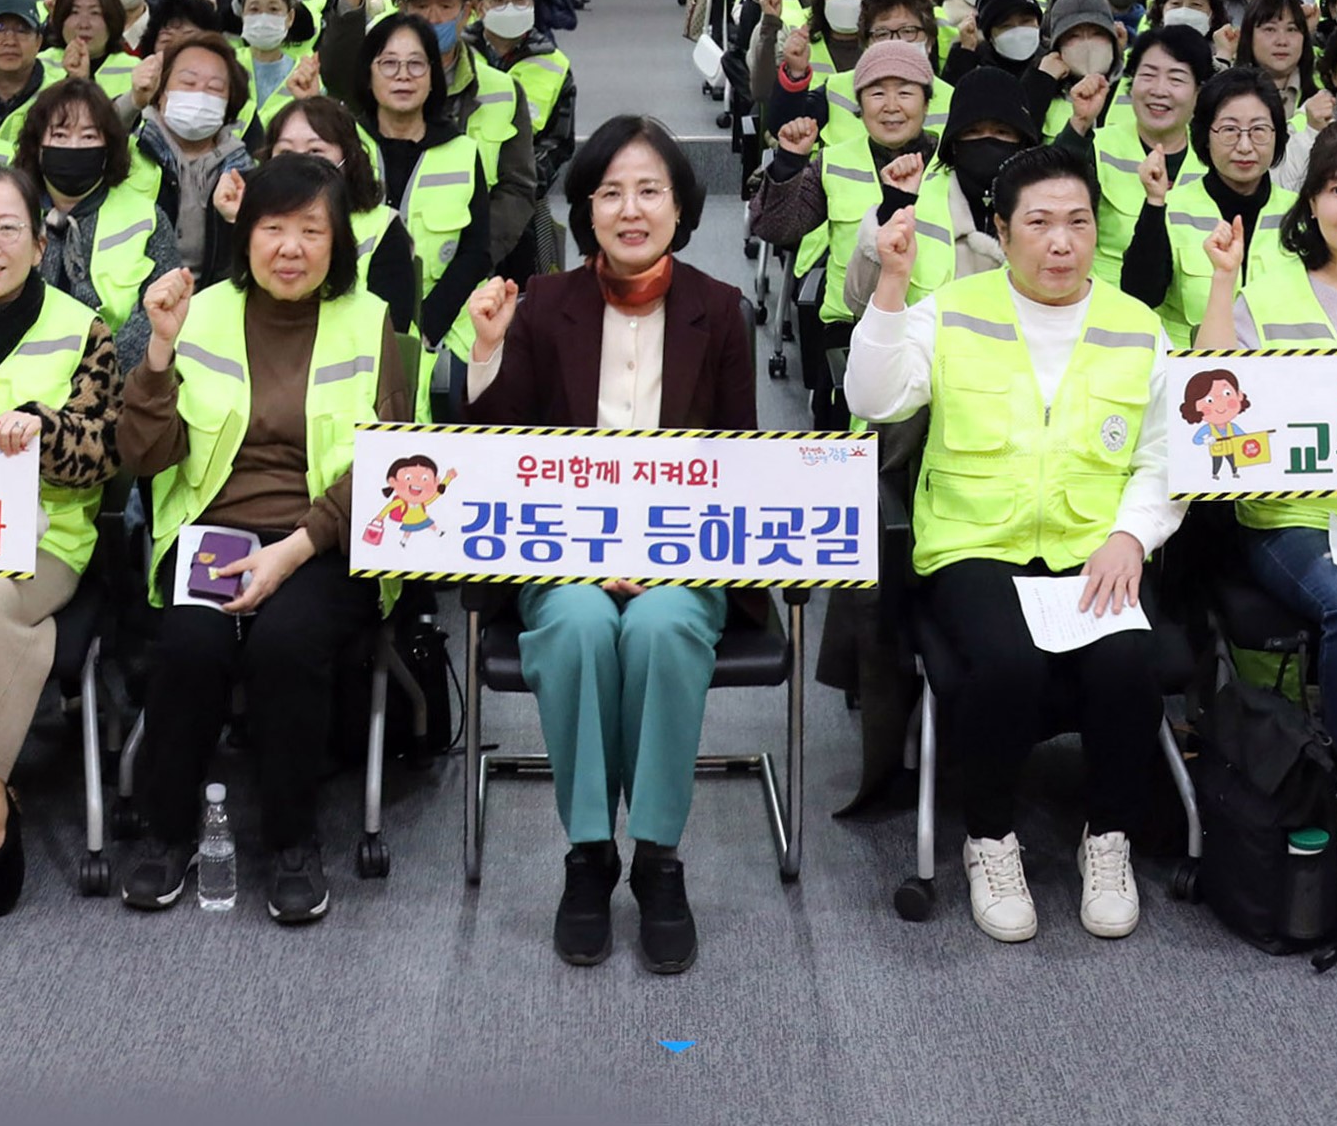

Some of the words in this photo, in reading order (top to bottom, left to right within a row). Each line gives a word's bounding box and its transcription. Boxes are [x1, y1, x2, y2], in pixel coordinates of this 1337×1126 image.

[517, 455, 620, 488] 우리함께
[633, 459, 718, 488] 지켜요!
[461, 502, 622, 563] 강동구
[644, 504, 859, 565] 등하굣길
